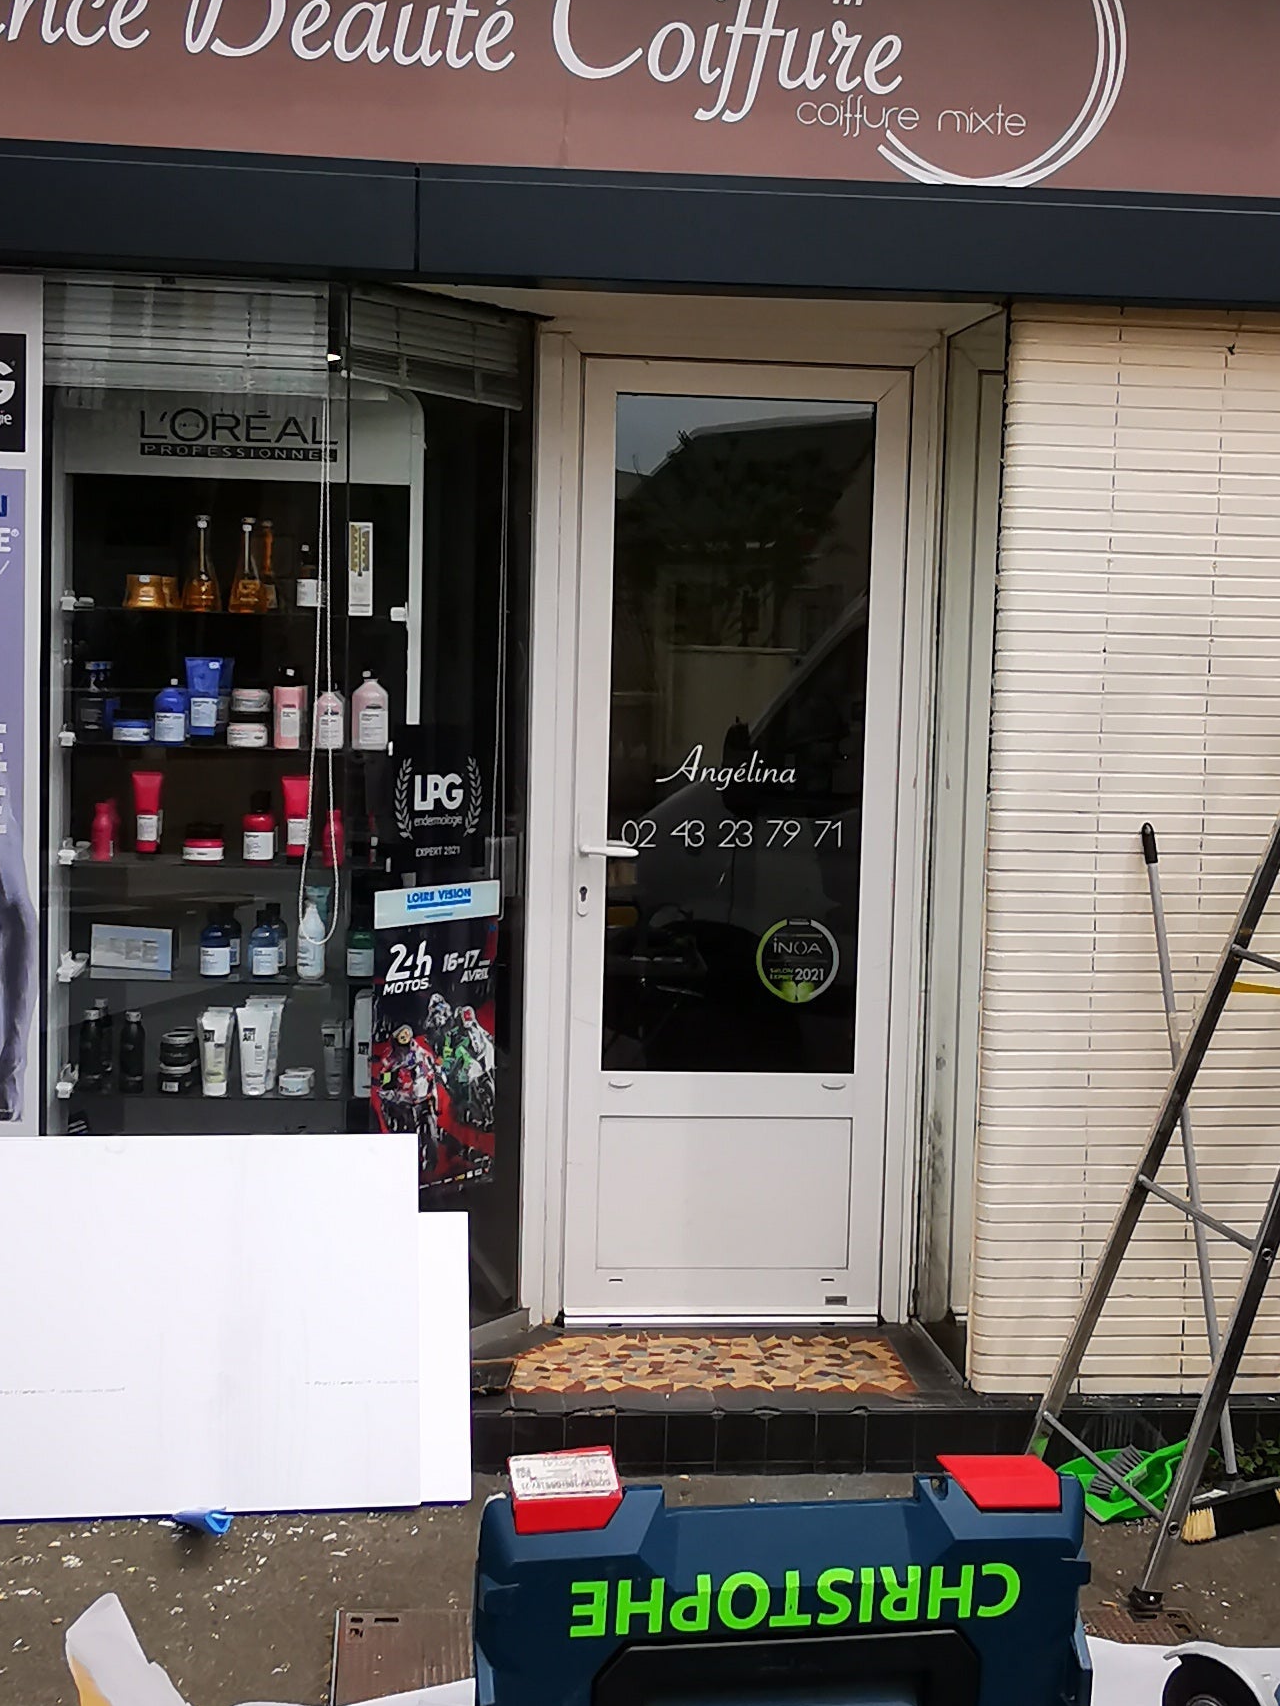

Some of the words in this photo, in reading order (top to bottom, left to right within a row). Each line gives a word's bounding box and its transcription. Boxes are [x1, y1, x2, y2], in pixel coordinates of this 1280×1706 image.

[796, 94, 920, 137] coiffure
[937, 104, 1027, 137] mixte
[140, 408, 338, 445] L'ORÉAL
[656, 744, 797, 791] Angélina
[414, 773, 464, 811] LPG
[621, 819, 657, 849] 02
[670, 819, 705, 848] 43
[718, 819, 753, 848] 23
[766, 819, 801, 848] 79
[814, 819, 844, 848] 71
[406, 891, 435, 904] LOIRE
[438, 888, 471, 900] VISION
[383, 977, 430, 996] MOTOS
[460, 967, 489, 984] AVRIL
[795, 967, 824, 981] 2021
[569, 1562, 1021, 1638] CHRISTOPHE
